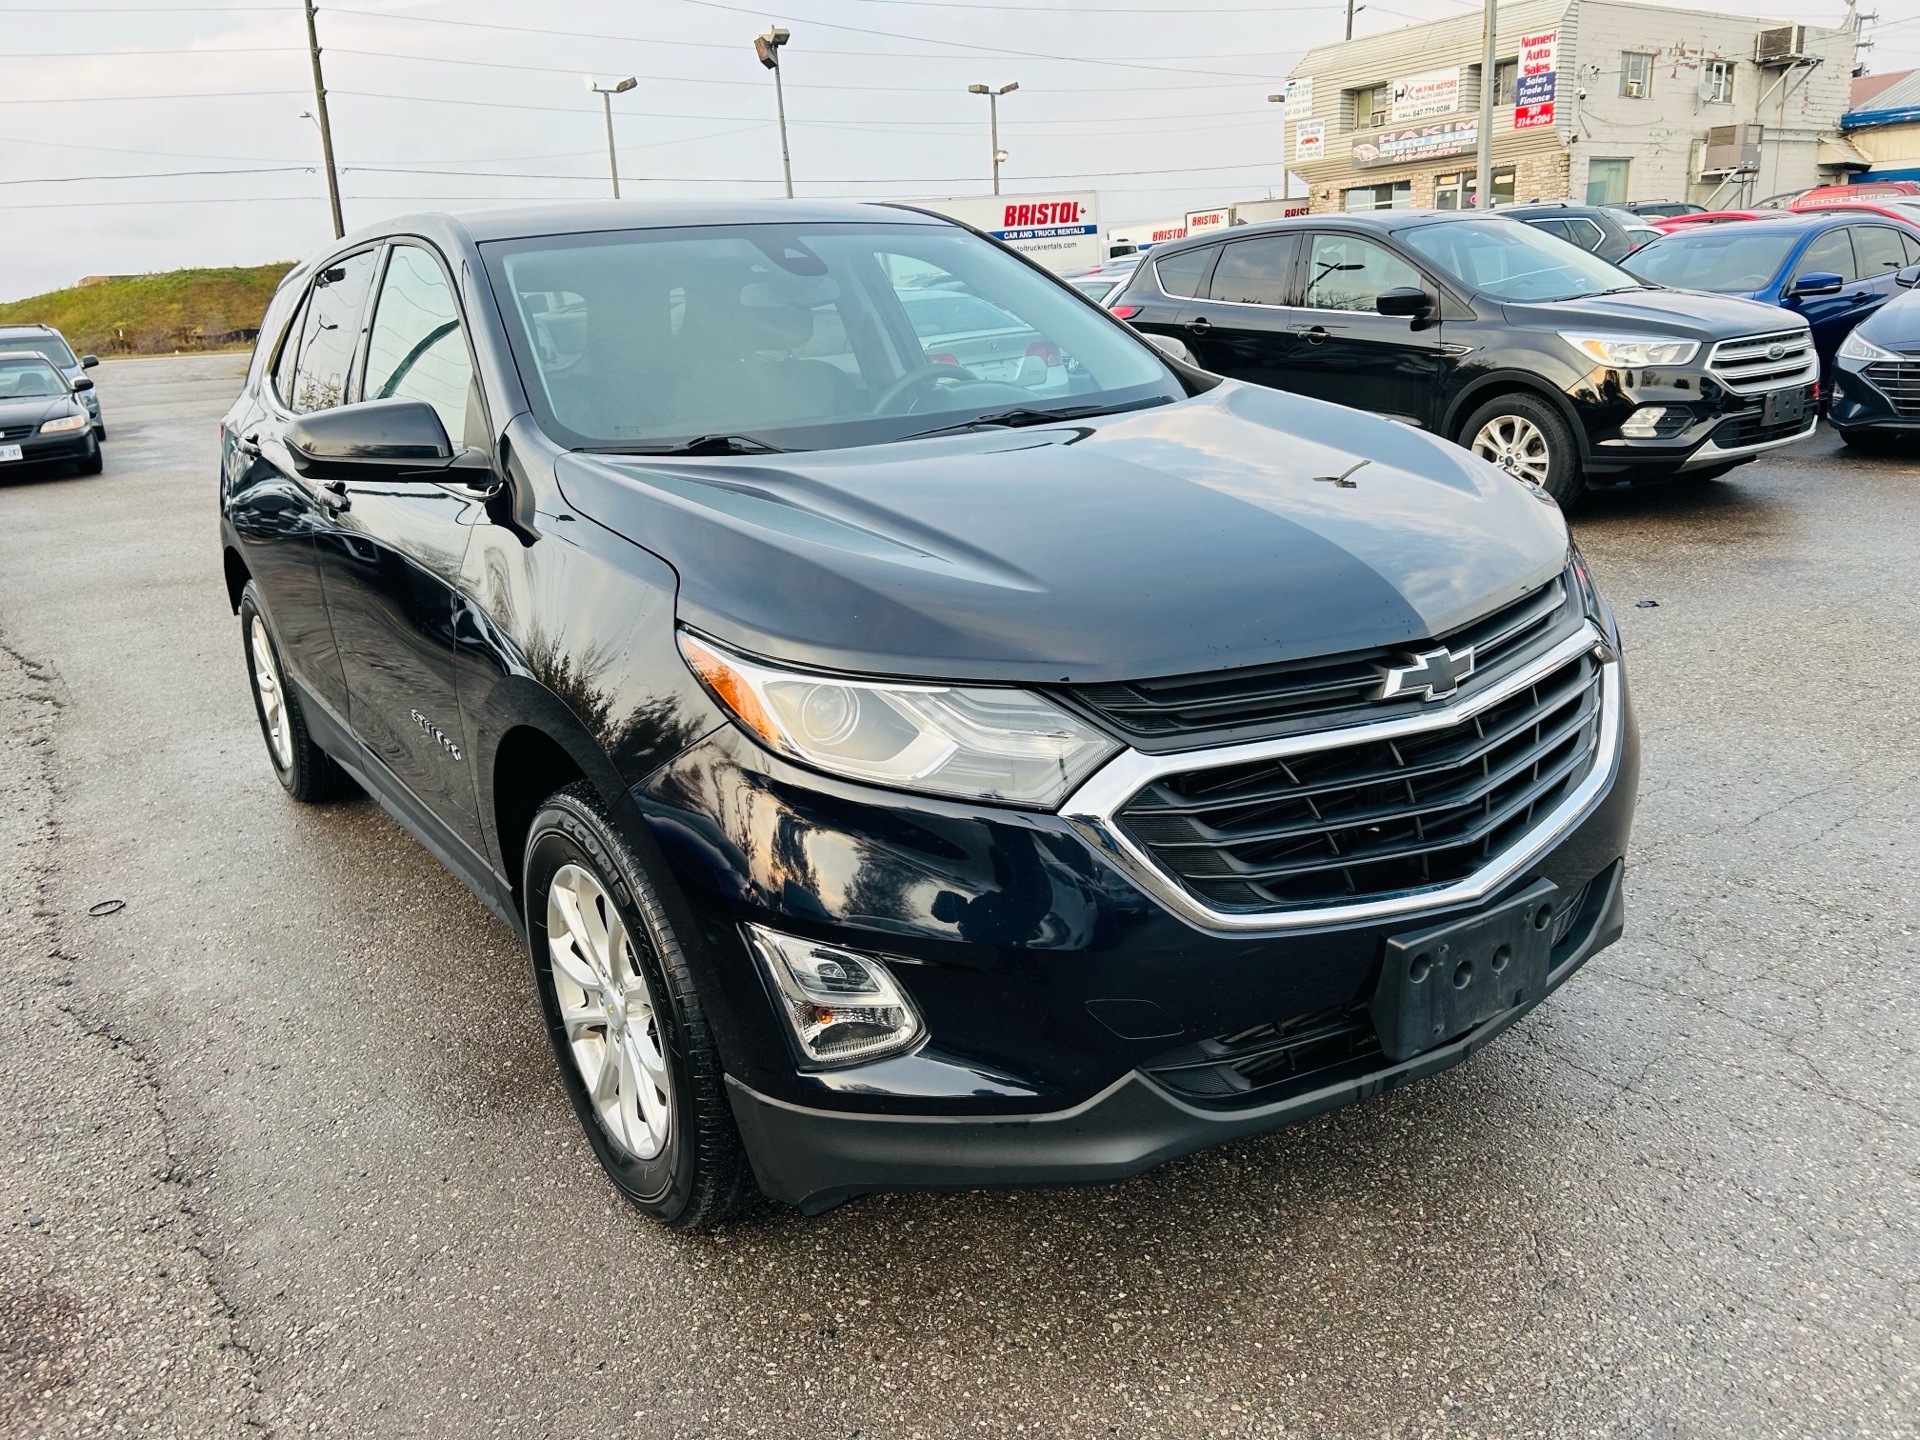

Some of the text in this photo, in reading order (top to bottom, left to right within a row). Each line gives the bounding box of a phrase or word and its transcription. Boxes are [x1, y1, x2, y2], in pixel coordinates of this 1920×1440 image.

[1521, 30, 1557, 48] Numeri
[1526, 49, 1551, 61] Auto
[1524, 62, 1551, 76] Sales
[1424, 84, 1435, 92] FINE
[1436, 79, 1457, 90] MOTORS
[1526, 74, 1548, 86] Sales
[1520, 83, 1553, 96] Trade In
[1415, 93, 1432, 101] QUALITY
[1520, 94, 1551, 105] Finance
[1379, 119, 1479, 143] HAKIM
[1380, 138, 1426, 152] AUTO
[1003, 202, 1080, 227] BRISTOL
[1192, 214, 1220, 226] BRISTOL
[1034, 229, 1056, 238] TRUCK
[1057, 227, 1085, 236] RENTALS
[1014, 242, 1077, 252] toltruckrentals.com
